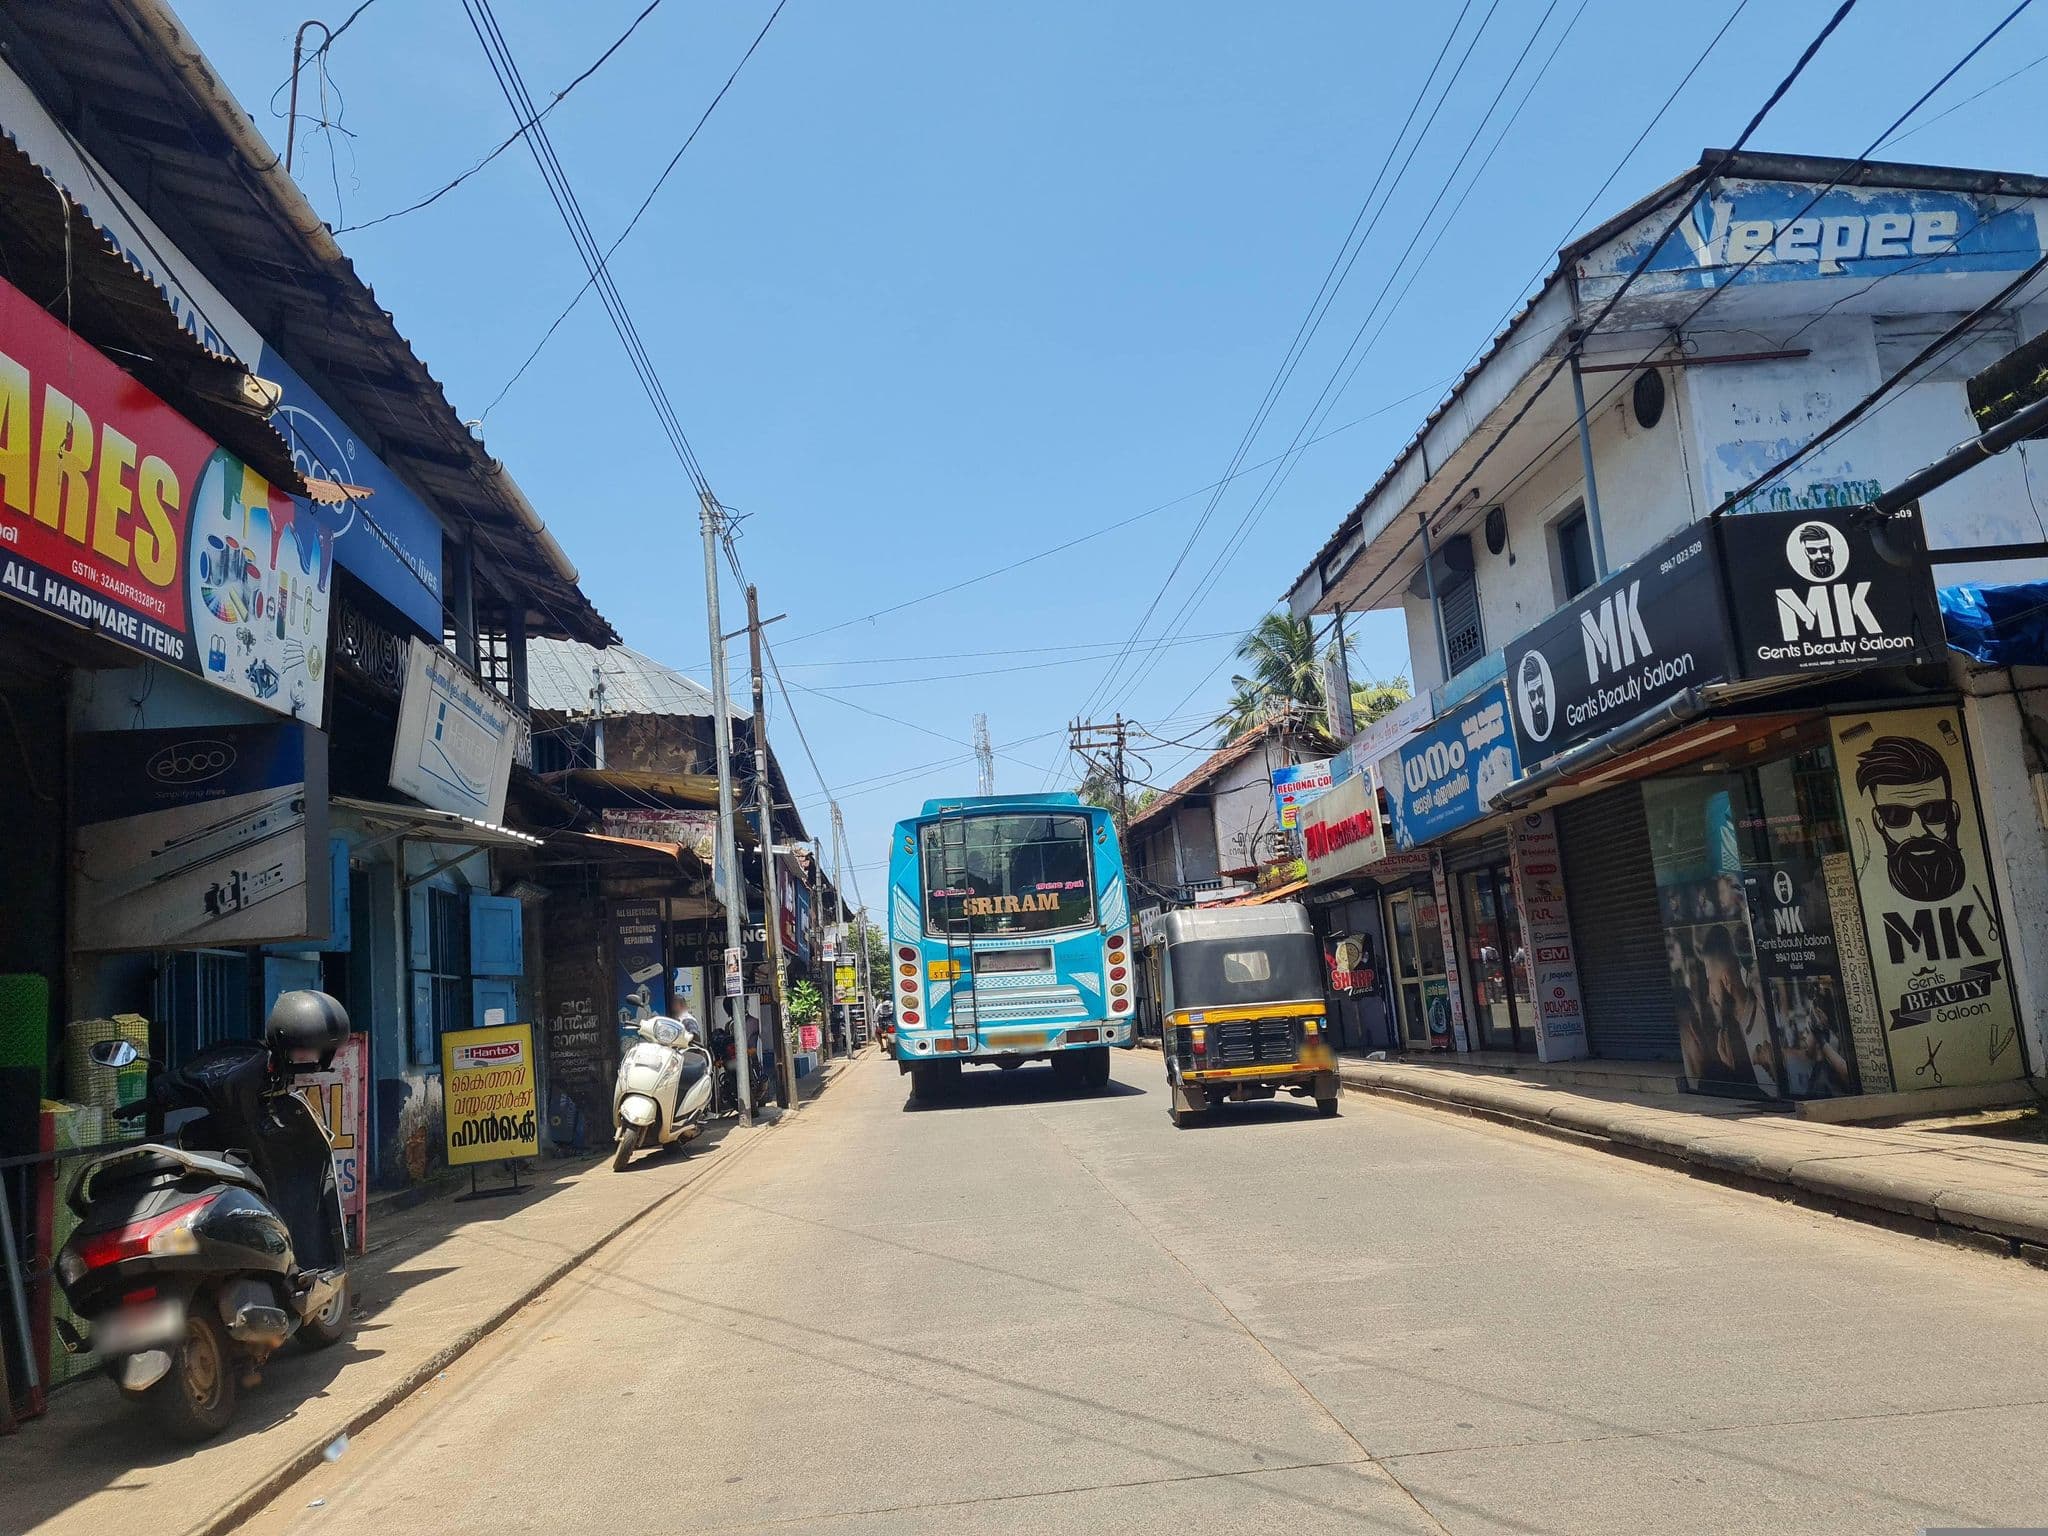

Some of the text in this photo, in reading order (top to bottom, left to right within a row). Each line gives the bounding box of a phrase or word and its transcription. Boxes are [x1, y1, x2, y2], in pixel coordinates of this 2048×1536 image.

[1676, 193, 1959, 288] Veepee
[71, 560, 99, 583] GSTIN:
[2, 561, 184, 661] ALL HARDWARE ITEMS
[1775, 581, 1883, 642] MK
[1580, 579, 1653, 685] MK
[1758, 635, 1914, 660] Gents Beauty Saloon
[1566, 652, 1695, 727] Gents Beauty Saloon
[157, 748, 225, 777] ebco
[1405, 740, 1466, 793] ധനം
[1277, 780, 1316, 795] REGIONAL
[963, 893, 1061, 916] SRIRAM
[1773, 905, 1804, 935] MK
[1803, 933, 1832, 947] Saloon
[1882, 904, 1986, 964] MK
[1775, 953, 1790, 963] 9947
[1803, 951, 1816, 961] 509
[675, 984, 692, 993] FIT
[934, 971, 955, 979] STO
[1907, 972, 1946, 991] Gents
[1906, 979, 1985, 1011] BEAUTY
[1936, 1002, 1992, 1022] Saloon
